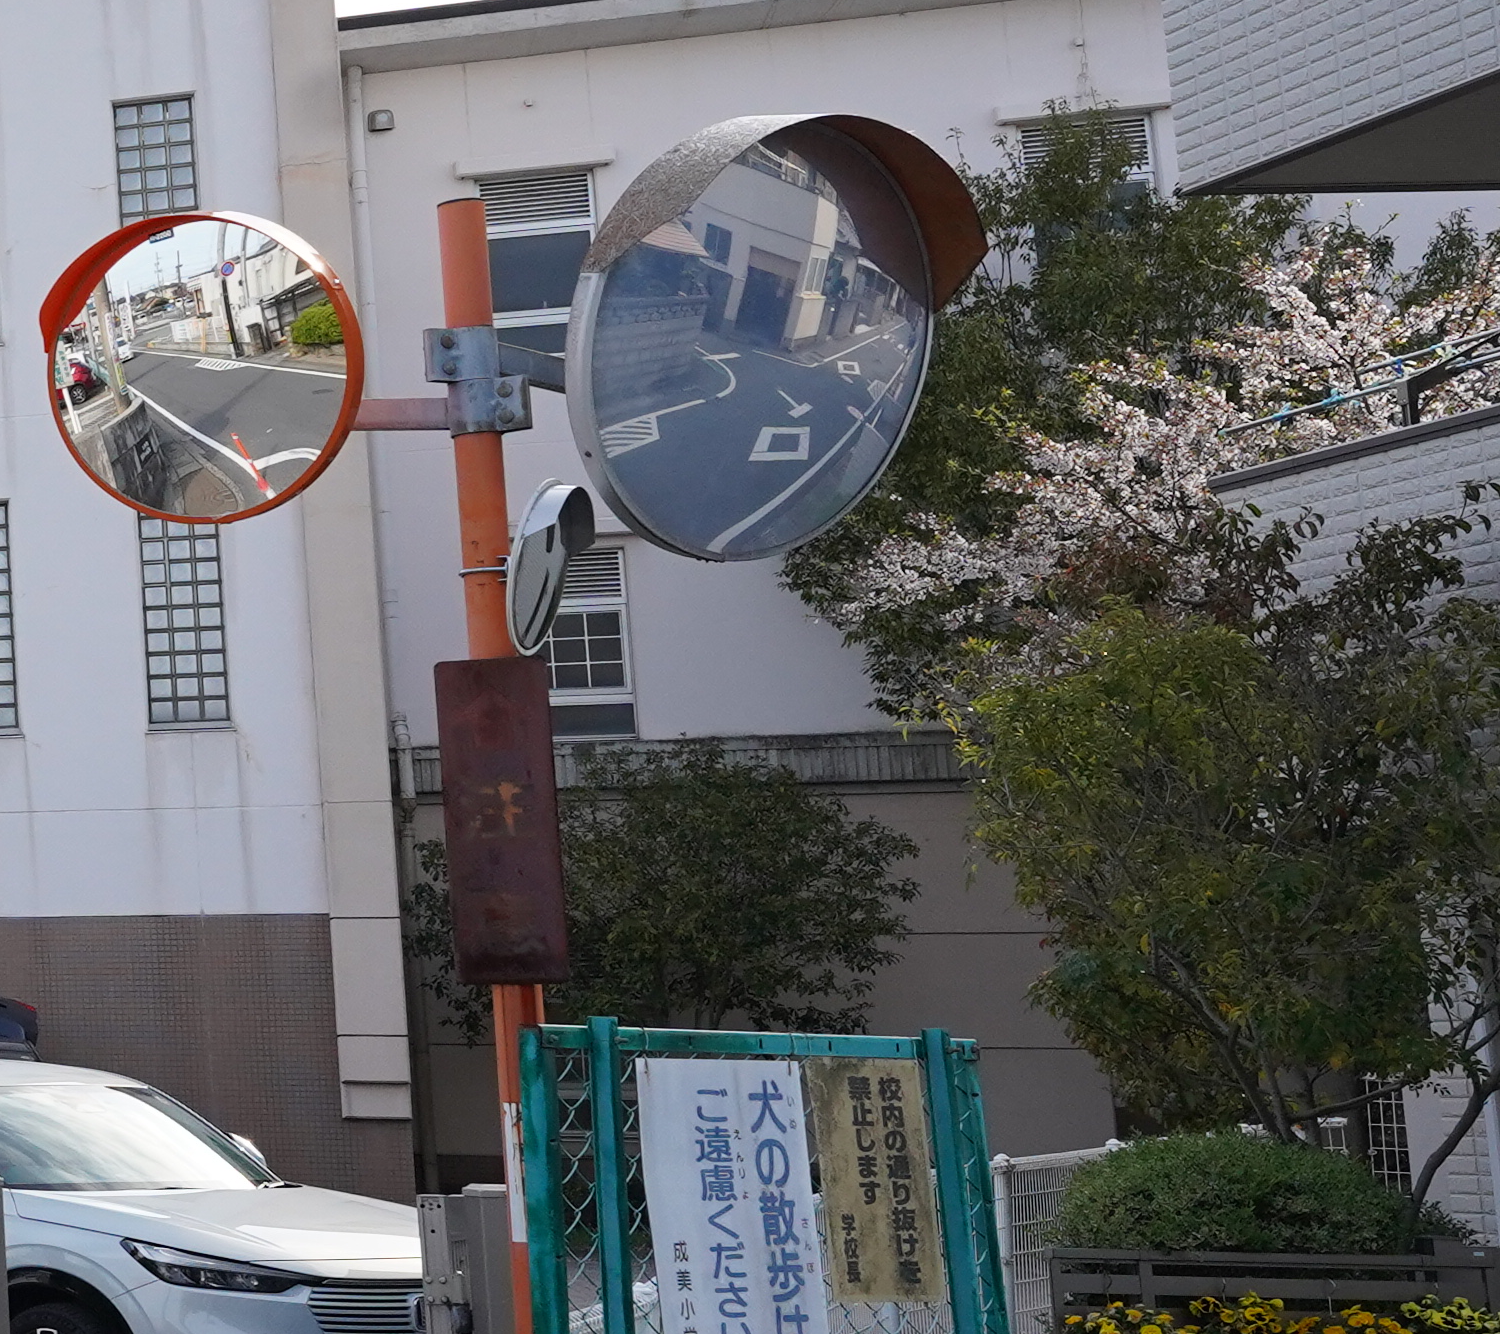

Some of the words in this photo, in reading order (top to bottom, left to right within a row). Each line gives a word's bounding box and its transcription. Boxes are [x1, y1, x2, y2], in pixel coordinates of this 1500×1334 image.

[846, 1075, 882, 1206] 禁止します
[878, 1076, 922, 1285] 校内の通り抜けを
[841, 1213, 862, 1284] 学校長
